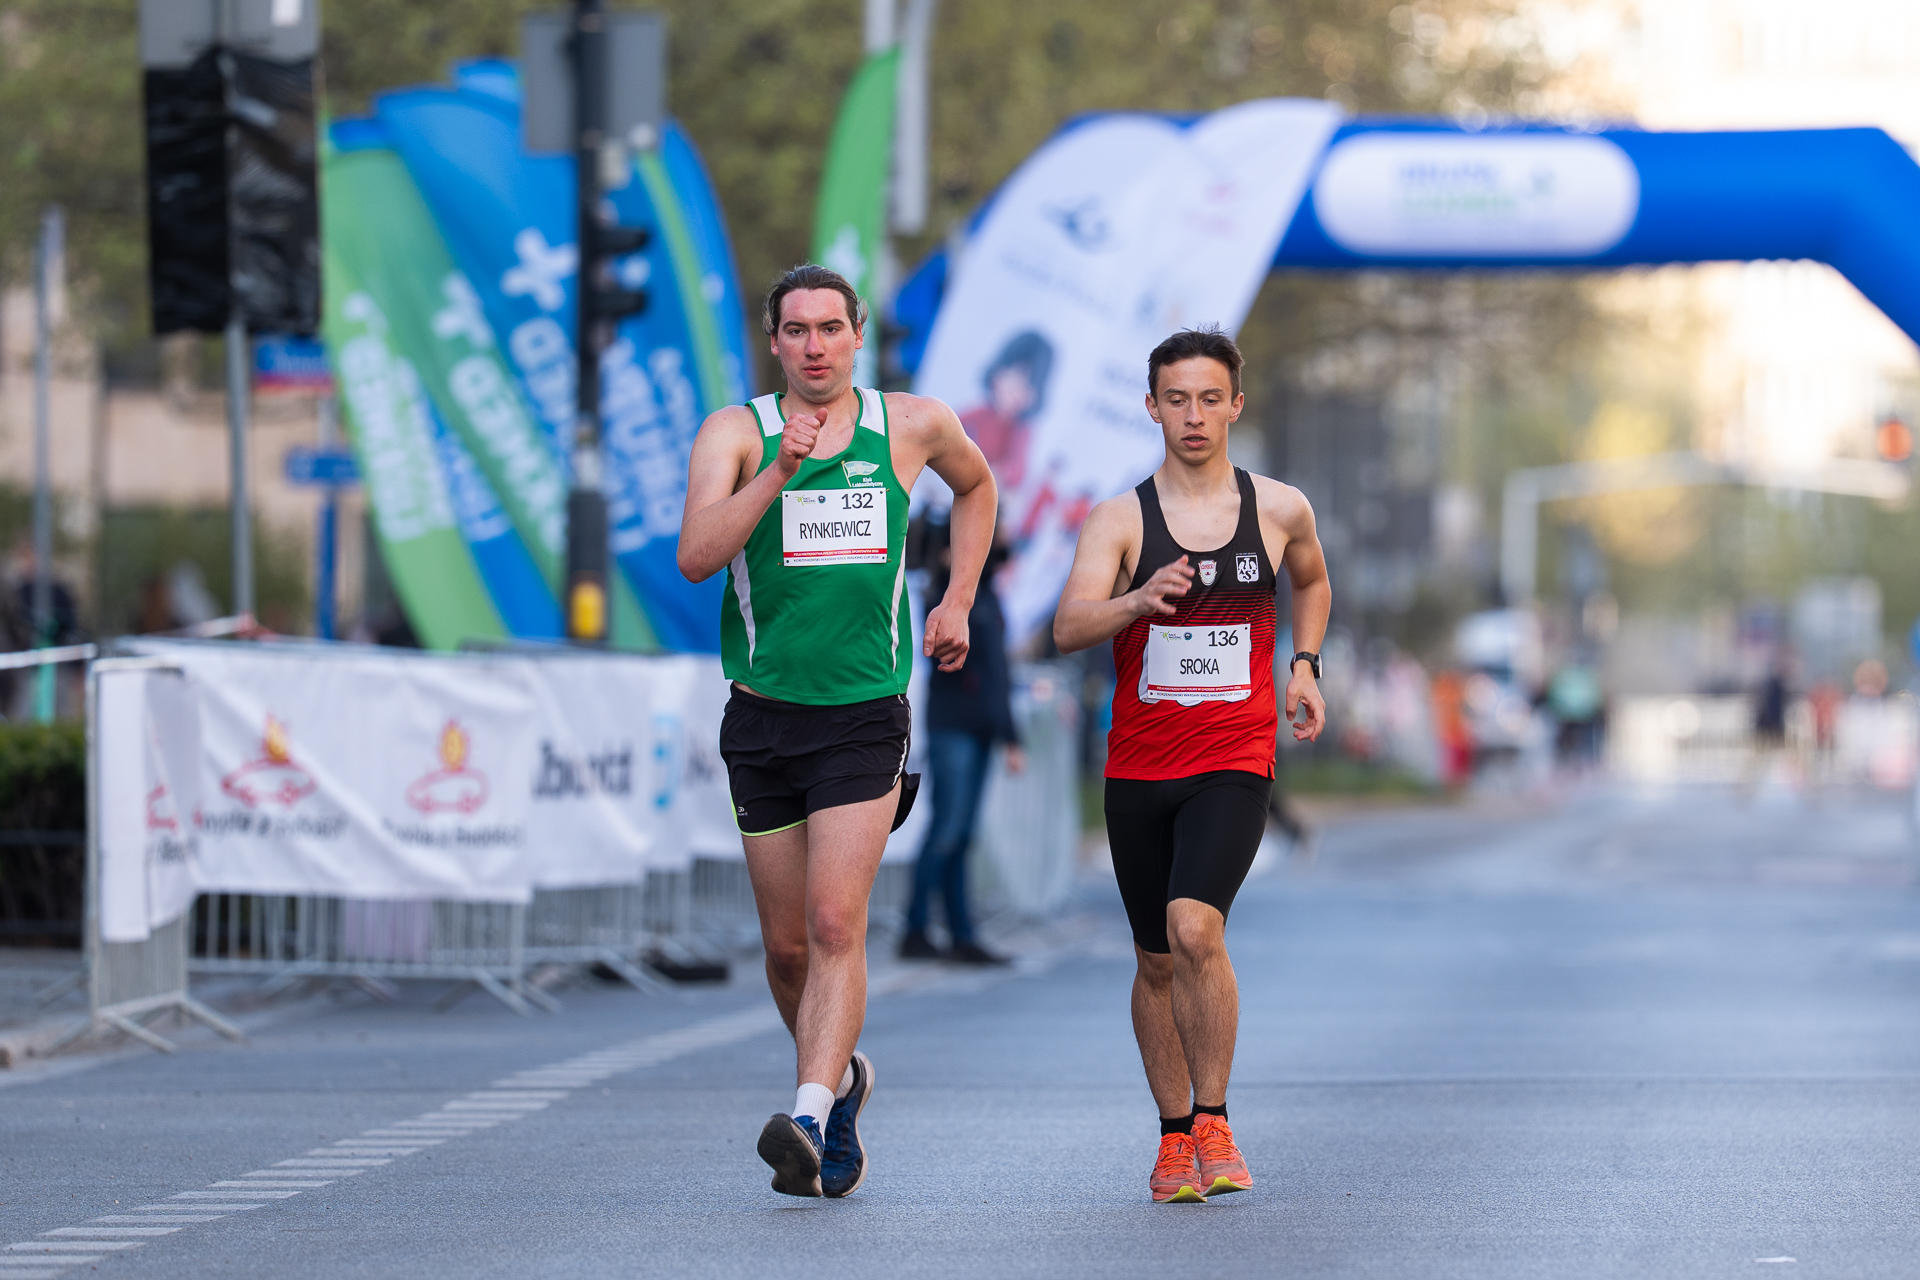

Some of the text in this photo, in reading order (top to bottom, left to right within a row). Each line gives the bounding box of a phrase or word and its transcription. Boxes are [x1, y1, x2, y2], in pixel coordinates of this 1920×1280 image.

[841, 492, 874, 510] 132
[799, 520, 872, 540] RYNKIEWICZ
[1207, 629, 1239, 647] 136
[1179, 658, 1220, 675] SROKA
